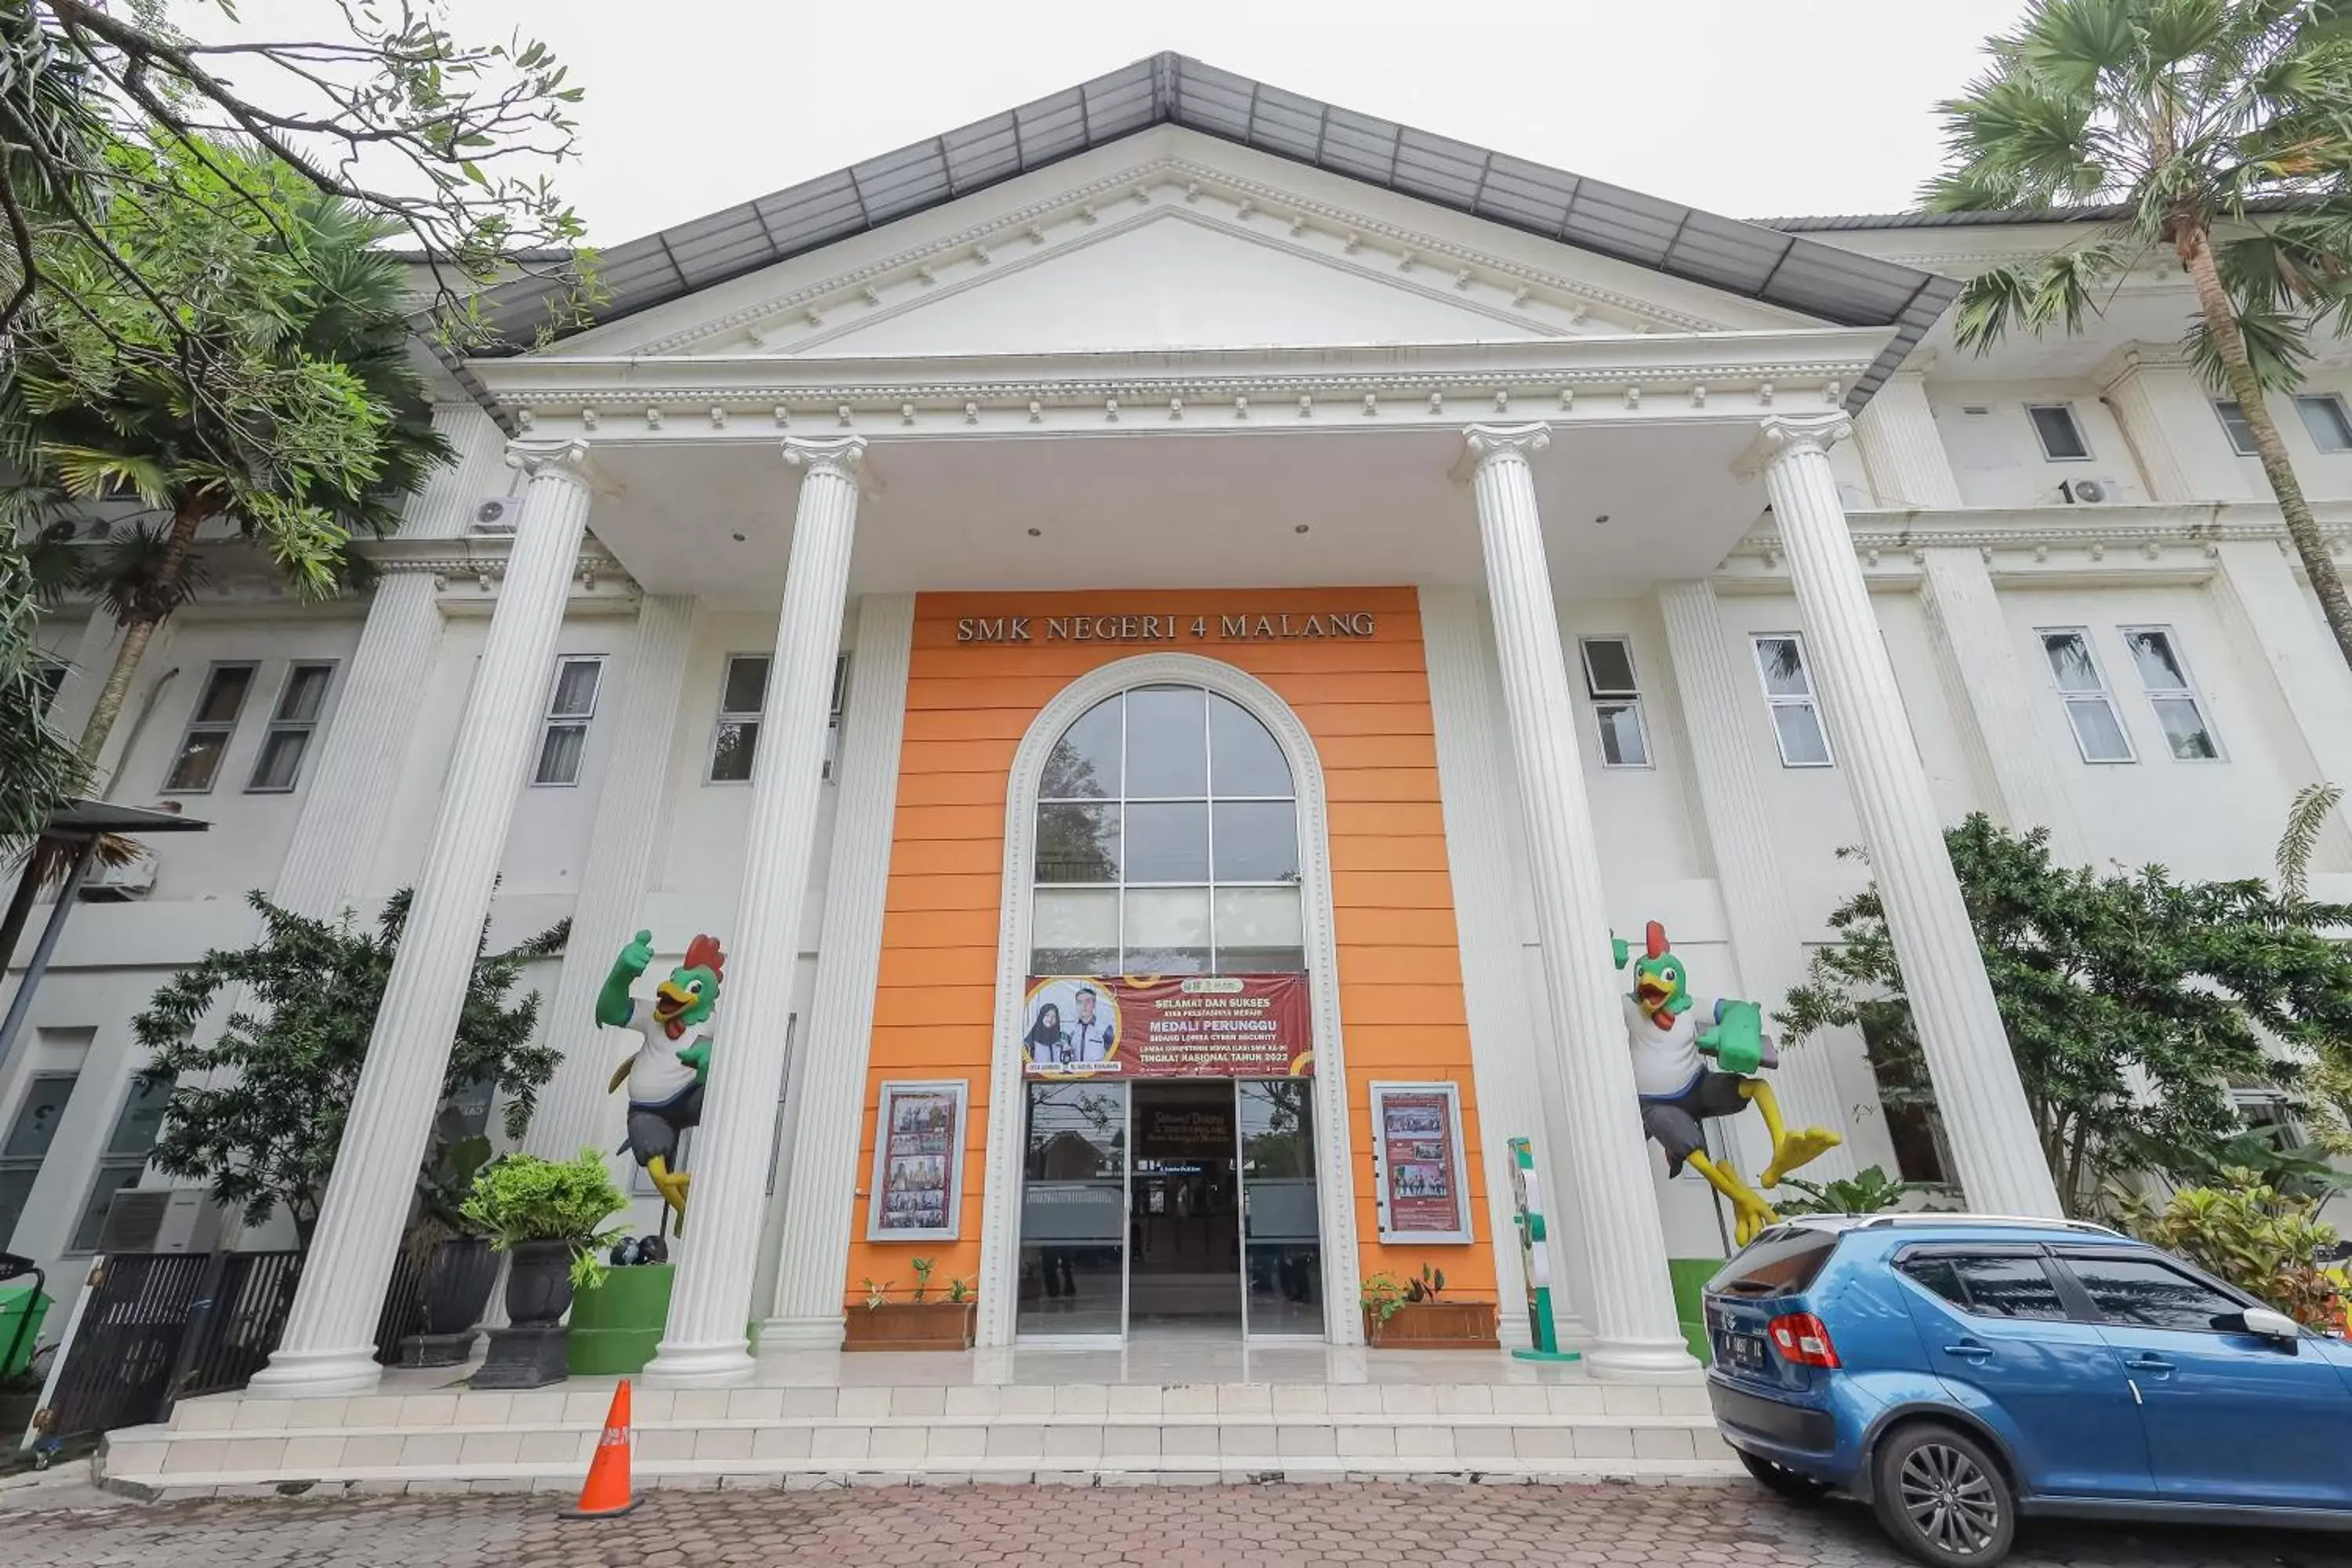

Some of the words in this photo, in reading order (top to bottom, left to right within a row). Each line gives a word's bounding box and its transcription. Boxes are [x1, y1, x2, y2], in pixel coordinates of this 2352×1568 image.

[957, 618, 1030, 641] SMK
[1047, 615, 1177, 640] NEGERI
[1191, 615, 1206, 638] 4
[1220, 612, 1374, 637] MALANG
[1155, 999, 1202, 1009] SELAMAT
[1205, 998, 1227, 1007] DAN
[1229, 998, 1270, 1007] SUKSES
[1150, 1021, 1199, 1033] MEDALI
[1203, 1020, 1277, 1031] PERUNGGU
[1231, 1053, 1261, 1062] TAHUN
